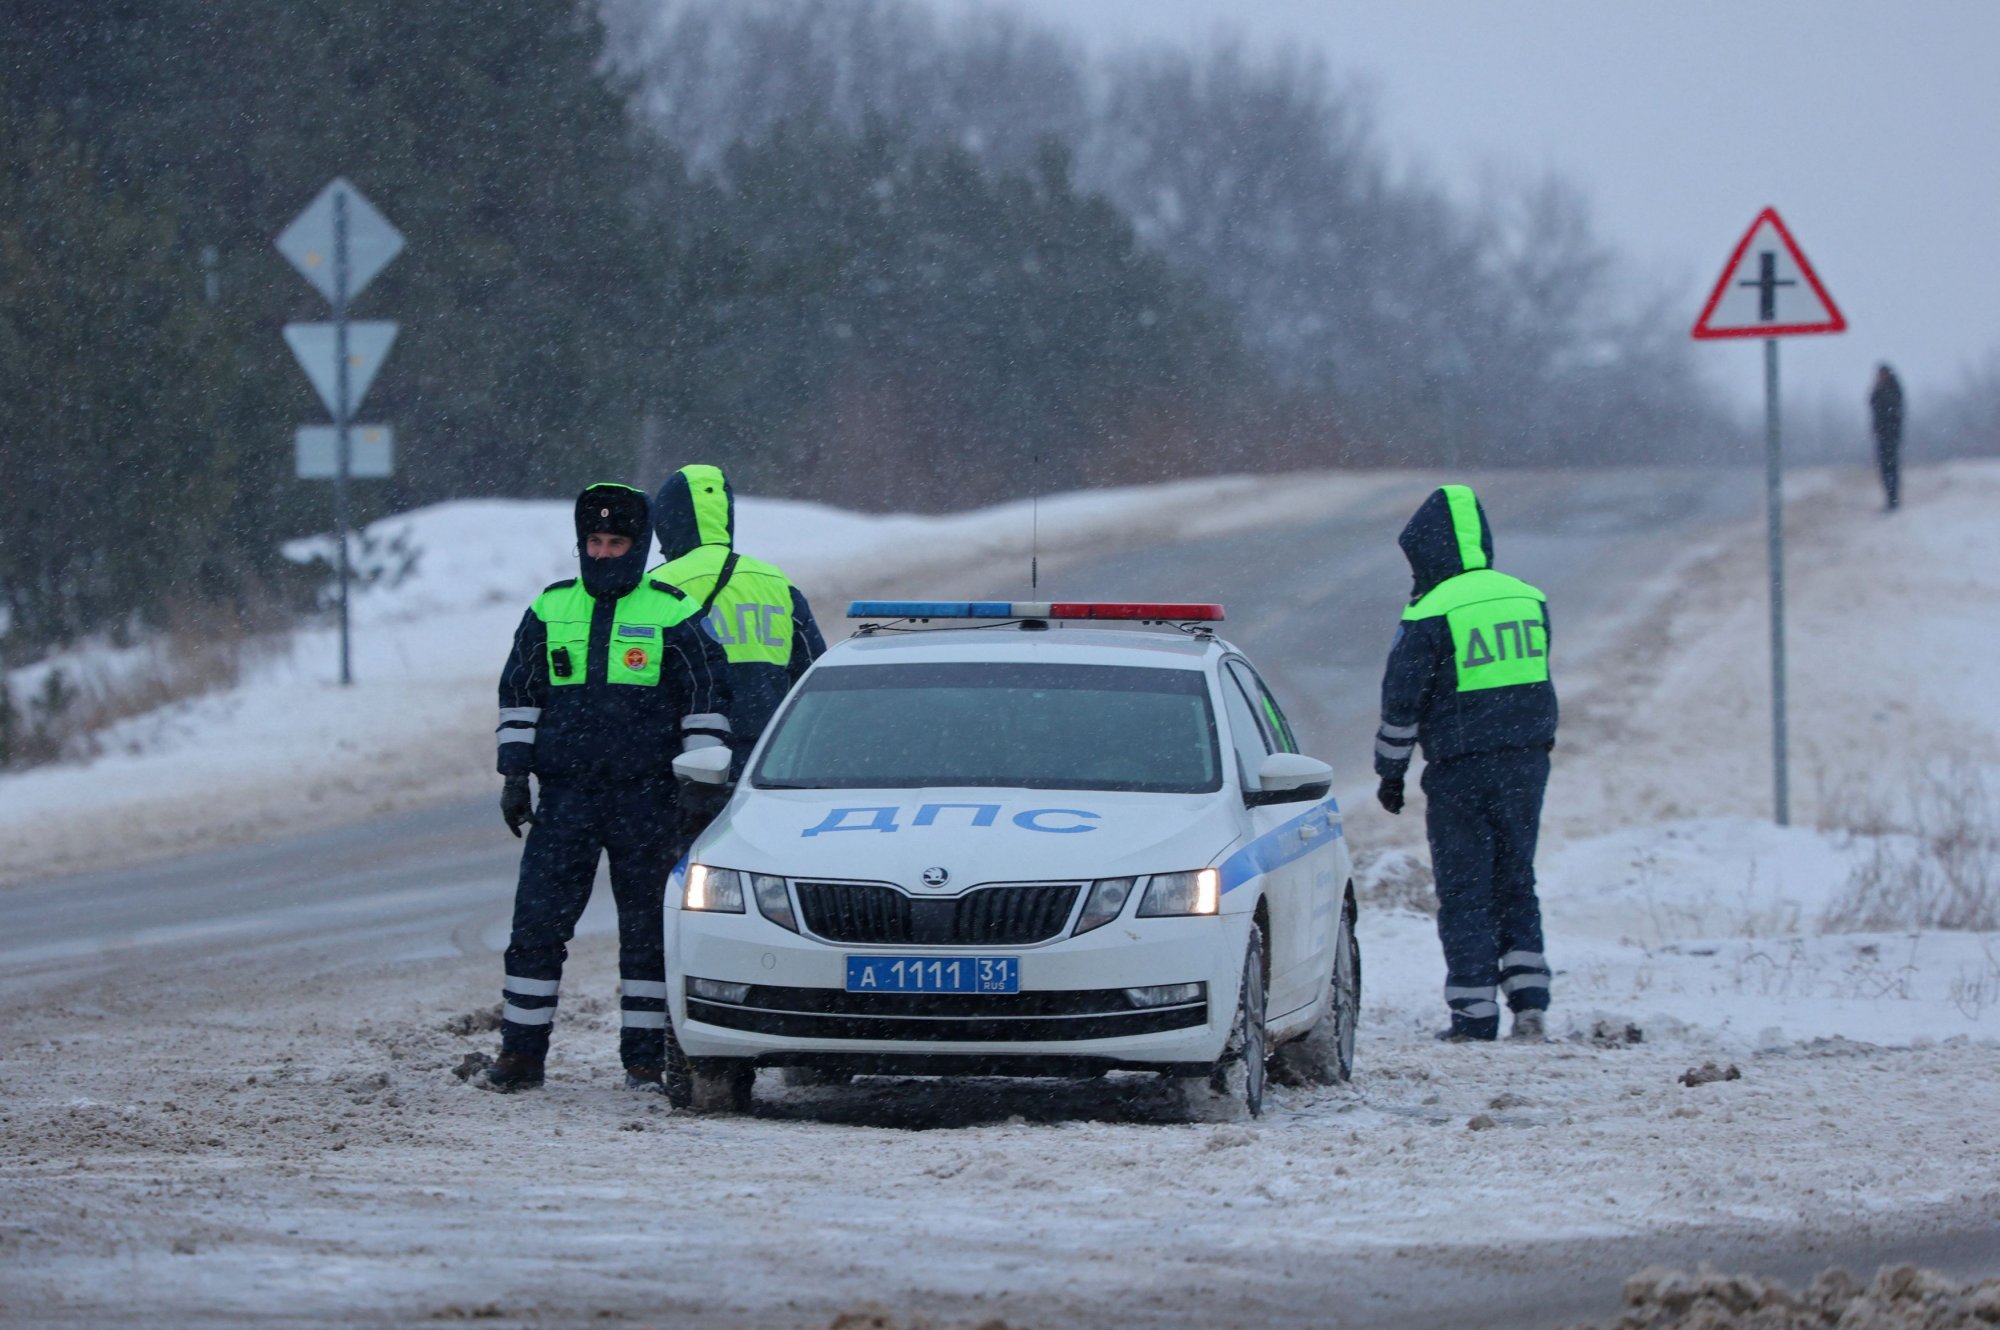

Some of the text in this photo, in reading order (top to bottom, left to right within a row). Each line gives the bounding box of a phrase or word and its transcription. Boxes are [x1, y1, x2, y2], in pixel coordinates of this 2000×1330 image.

[709, 604, 785, 646] ДПС
[1462, 619, 1544, 668] ДПС
[800, 803, 1102, 838] ДПС
[890, 960, 960, 988] 1111
[980, 960, 1007, 981] 31
[983, 982, 1006, 990] RUS
